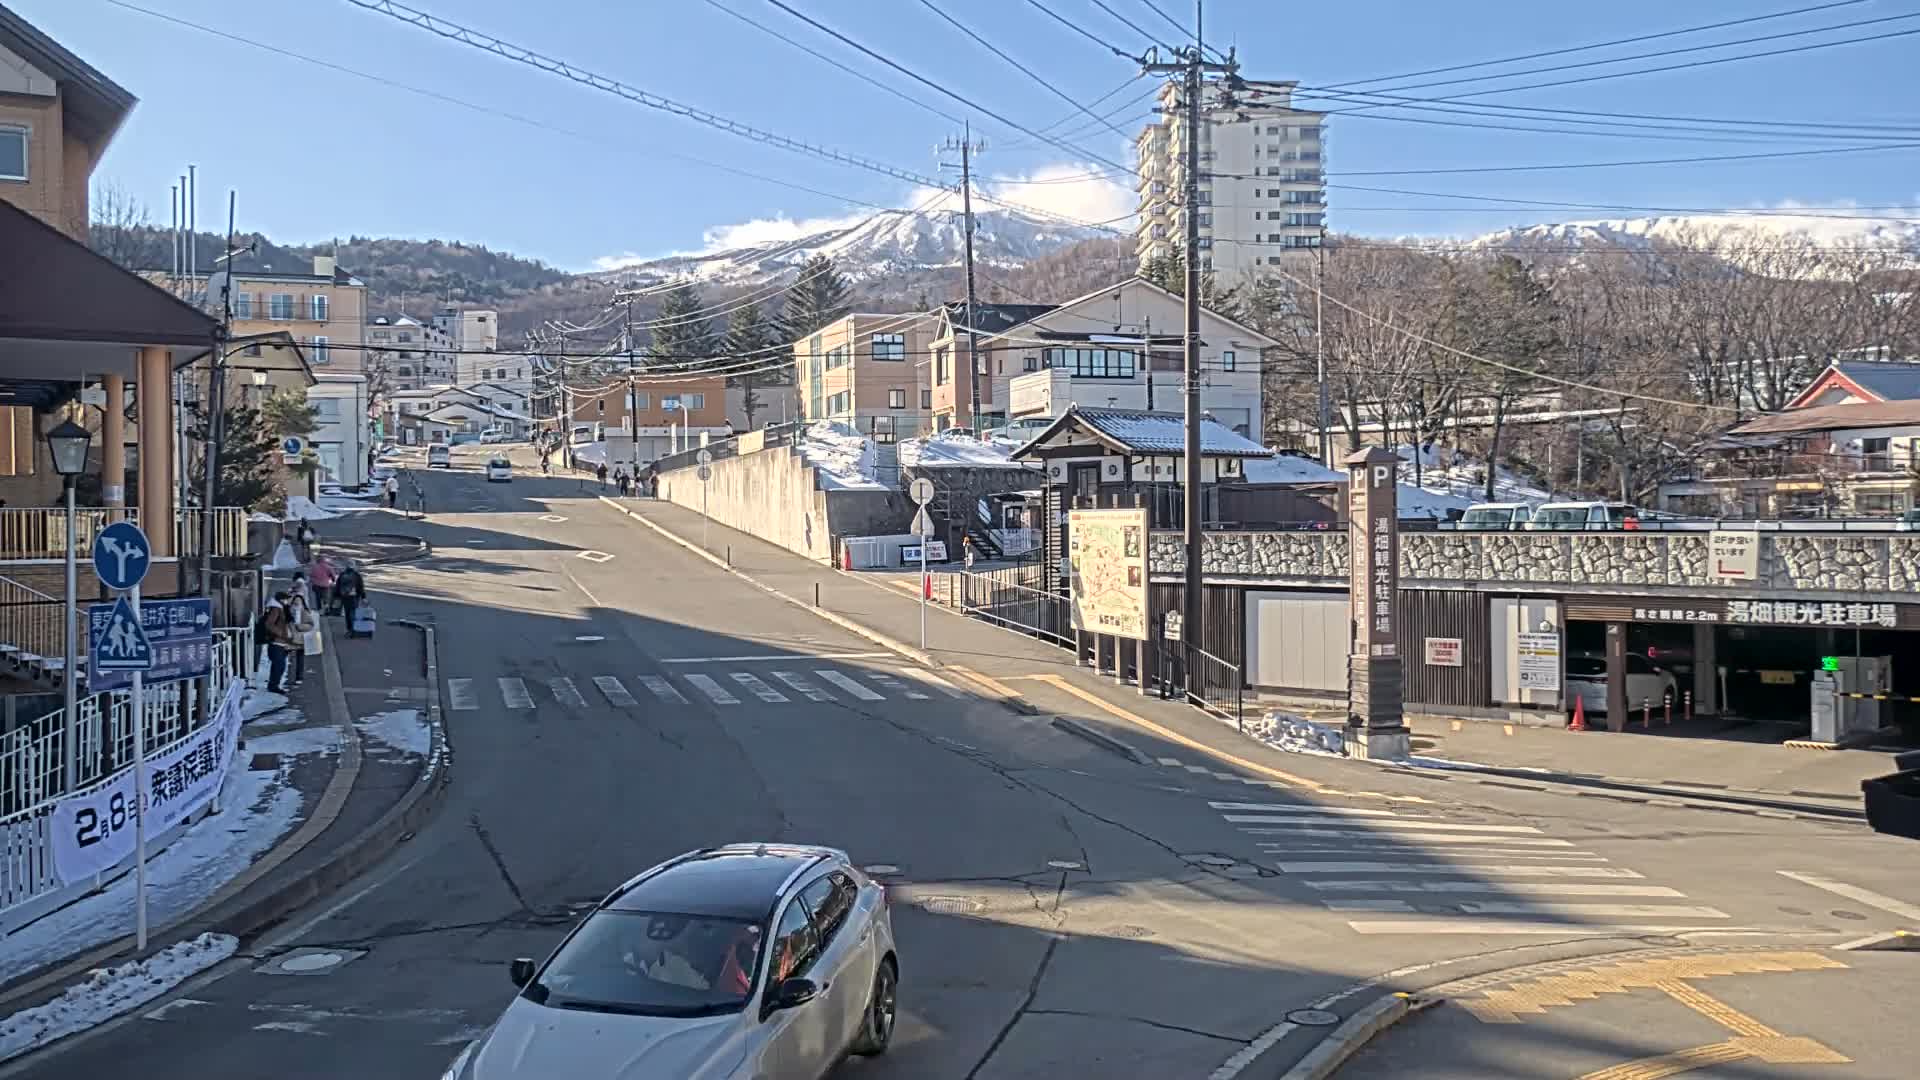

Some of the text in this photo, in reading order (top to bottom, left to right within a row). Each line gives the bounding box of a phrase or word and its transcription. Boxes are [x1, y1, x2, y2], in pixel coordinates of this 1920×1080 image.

[1354, 469, 1364, 488] P
[1374, 466, 1389, 488] P
[1374, 517, 1391, 633] 湯畑観光駐車場
[1726, 601, 1898, 627] 湯畑観光駐車場
